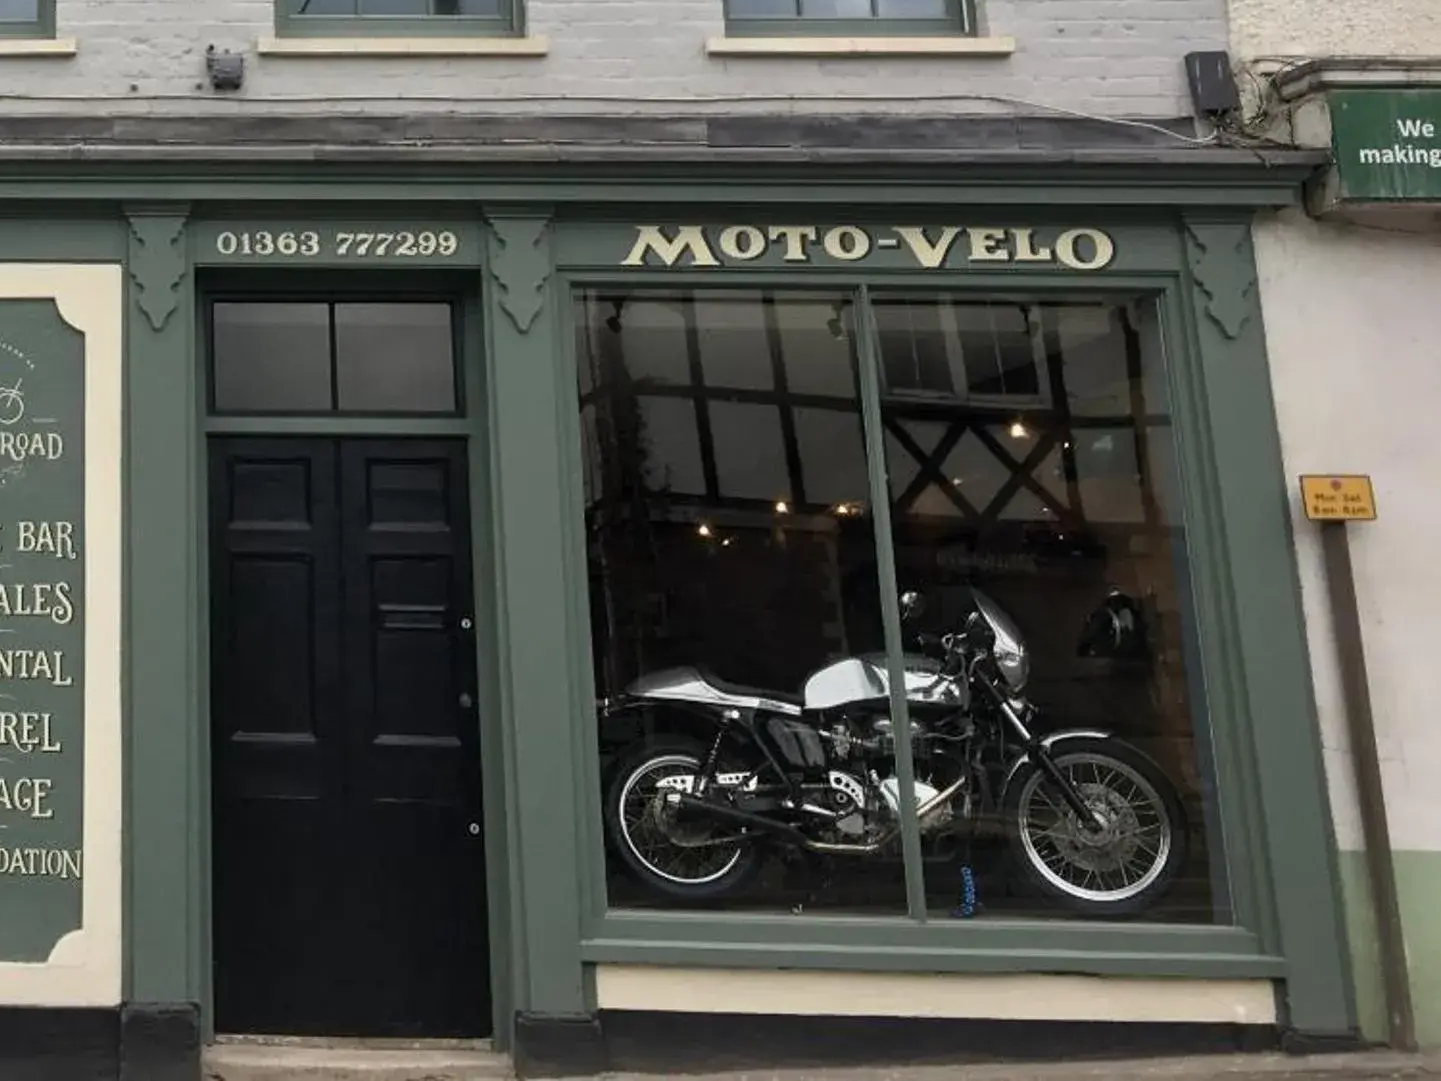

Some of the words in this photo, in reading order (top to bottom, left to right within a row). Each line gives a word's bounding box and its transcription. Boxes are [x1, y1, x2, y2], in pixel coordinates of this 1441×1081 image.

[1396, 119, 1435, 138] We
[1359, 145, 1441, 168] making
[216, 231, 320, 256] 01363
[336, 232, 458, 256] 777299
[621, 225, 1115, 270] MOTO-VELO
[0, 432, 63, 461] ROAD
[18, 521, 76, 560] BAR
